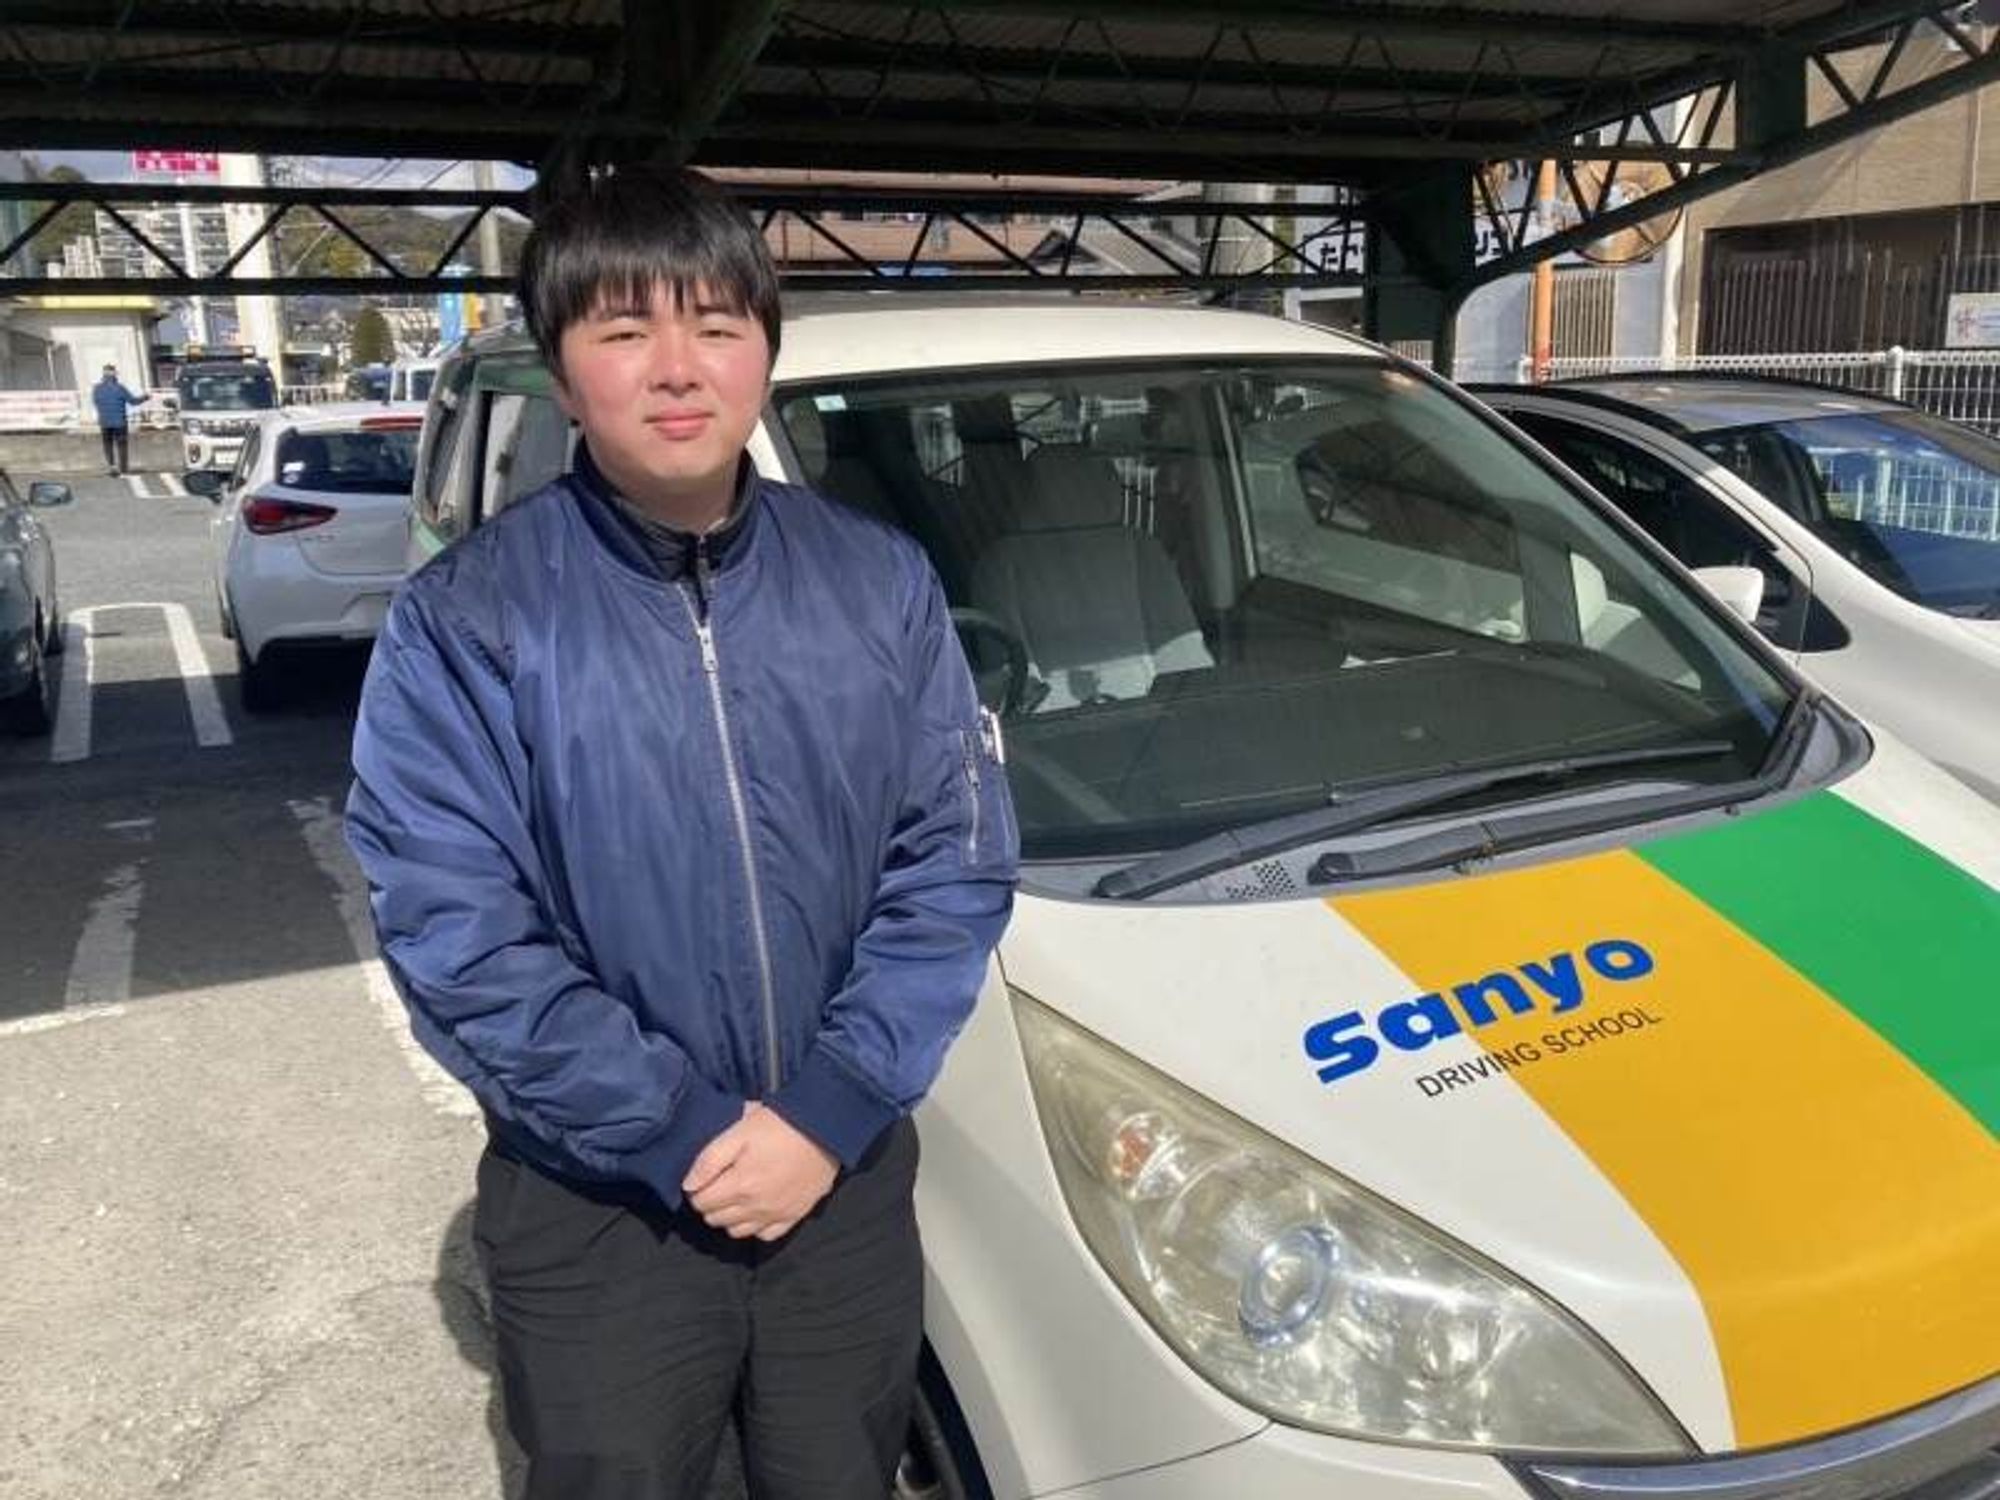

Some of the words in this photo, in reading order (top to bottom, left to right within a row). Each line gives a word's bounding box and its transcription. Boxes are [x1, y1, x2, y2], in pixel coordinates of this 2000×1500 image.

[1304, 940, 1653, 1084] sanyo
[1416, 1042, 1541, 1098] DRIVING
[1542, 1007, 1662, 1054] SCHOOL
